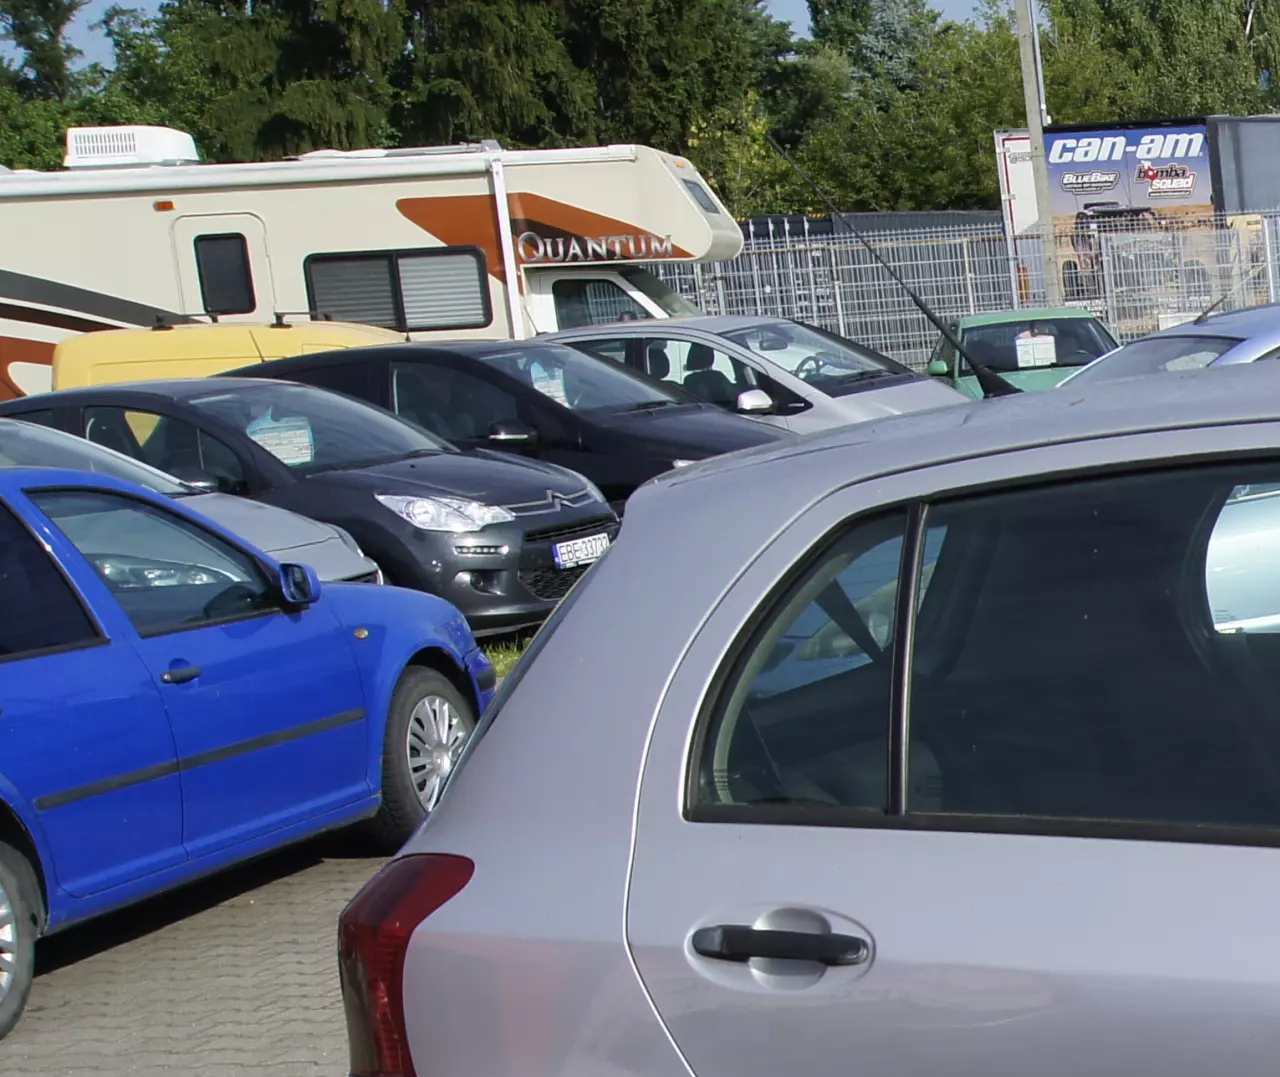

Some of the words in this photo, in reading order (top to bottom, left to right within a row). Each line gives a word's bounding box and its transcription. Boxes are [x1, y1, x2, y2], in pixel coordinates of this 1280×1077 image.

[1048, 132, 1204, 164] can-am
[518, 231, 673, 263] QUANTUM
[558, 541, 581, 563] EBE
